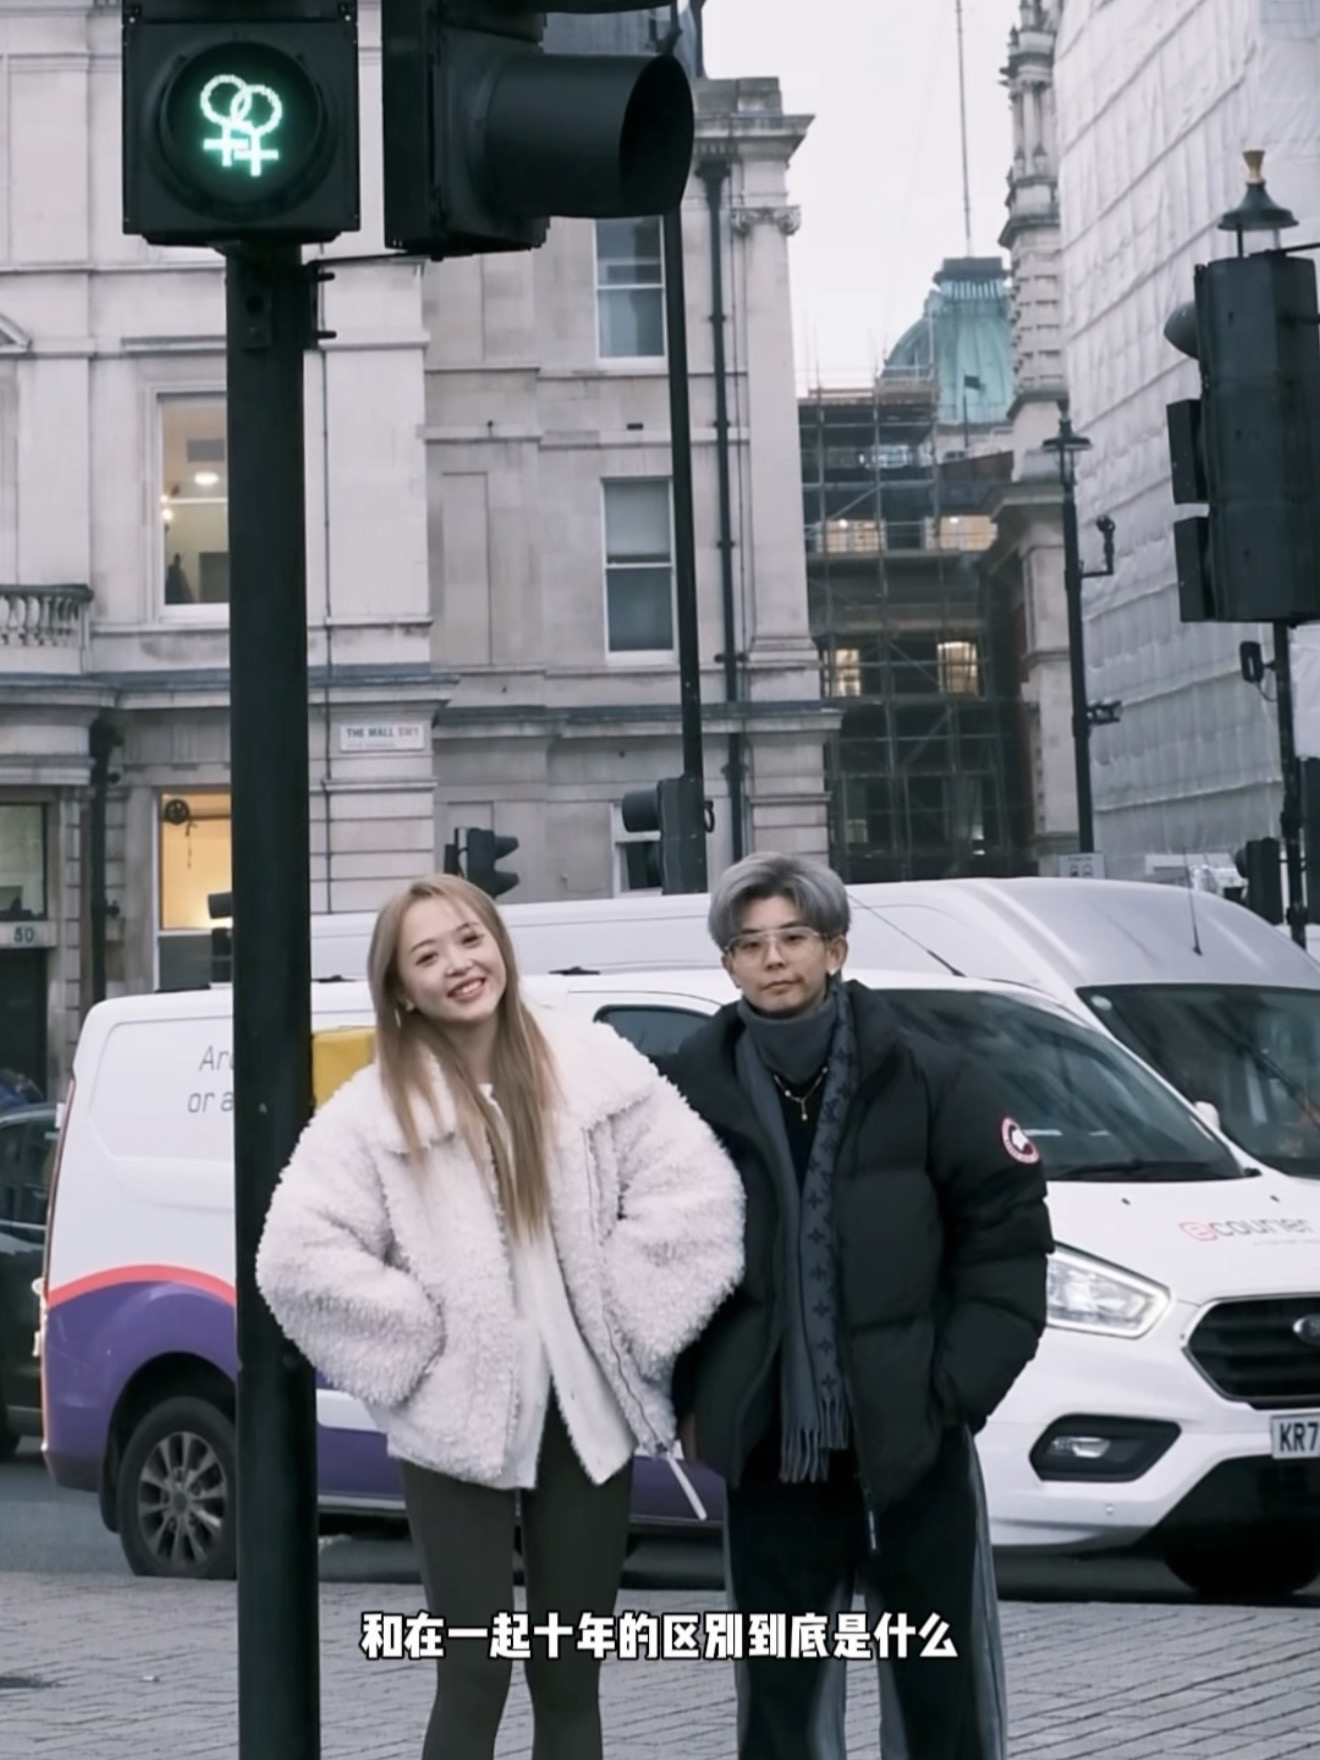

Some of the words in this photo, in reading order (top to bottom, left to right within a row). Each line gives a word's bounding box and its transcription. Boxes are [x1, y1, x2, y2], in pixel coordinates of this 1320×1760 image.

[346, 727, 365, 738] THE
[367, 727, 394, 738] MALL
[187, 1092, 215, 1113] or
[1280, 1421, 1319, 1452] KR7
